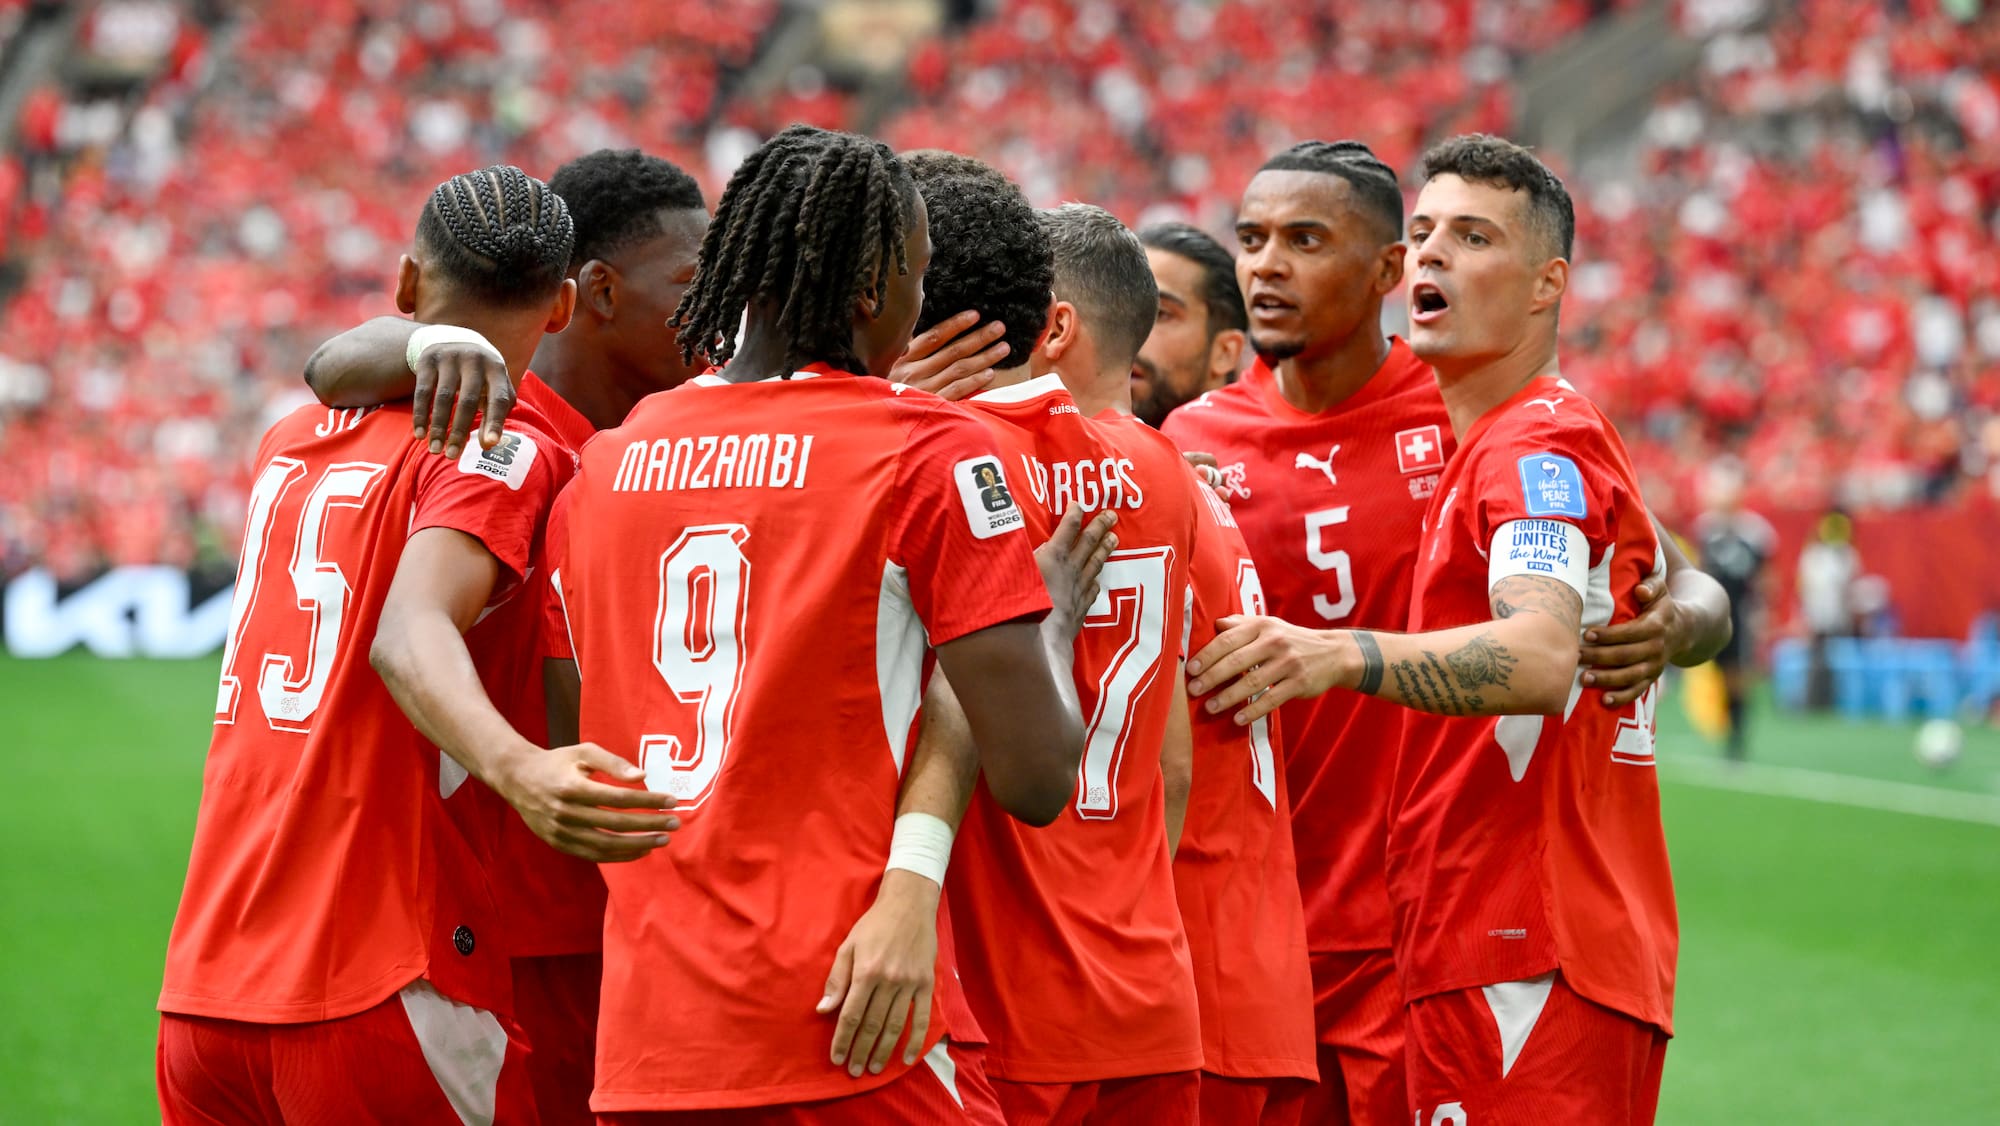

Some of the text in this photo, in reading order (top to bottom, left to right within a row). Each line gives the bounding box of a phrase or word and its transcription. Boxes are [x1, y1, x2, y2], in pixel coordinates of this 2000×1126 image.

[490, 453, 504, 462] FIFA
[612, 434, 814, 492] MANZAMBI
[475, 464, 507, 477] 2026
[991, 499, 1006, 508] FIFA
[1542, 490, 1571, 503] PEACE
[1550, 501, 1565, 509] FIFA
[990, 514, 1020, 529] 2026
[1513, 520, 1567, 538] FOOTBALL
[1513, 532, 1567, 553] UNITES
[1305, 507, 1356, 621] 5
[1509, 547, 1569, 568] the World
[1527, 561, 1553, 572] FIFA
[213, 456, 388, 734] 15
[637, 523, 751, 812] 9
[1075, 545, 1176, 821] 7
